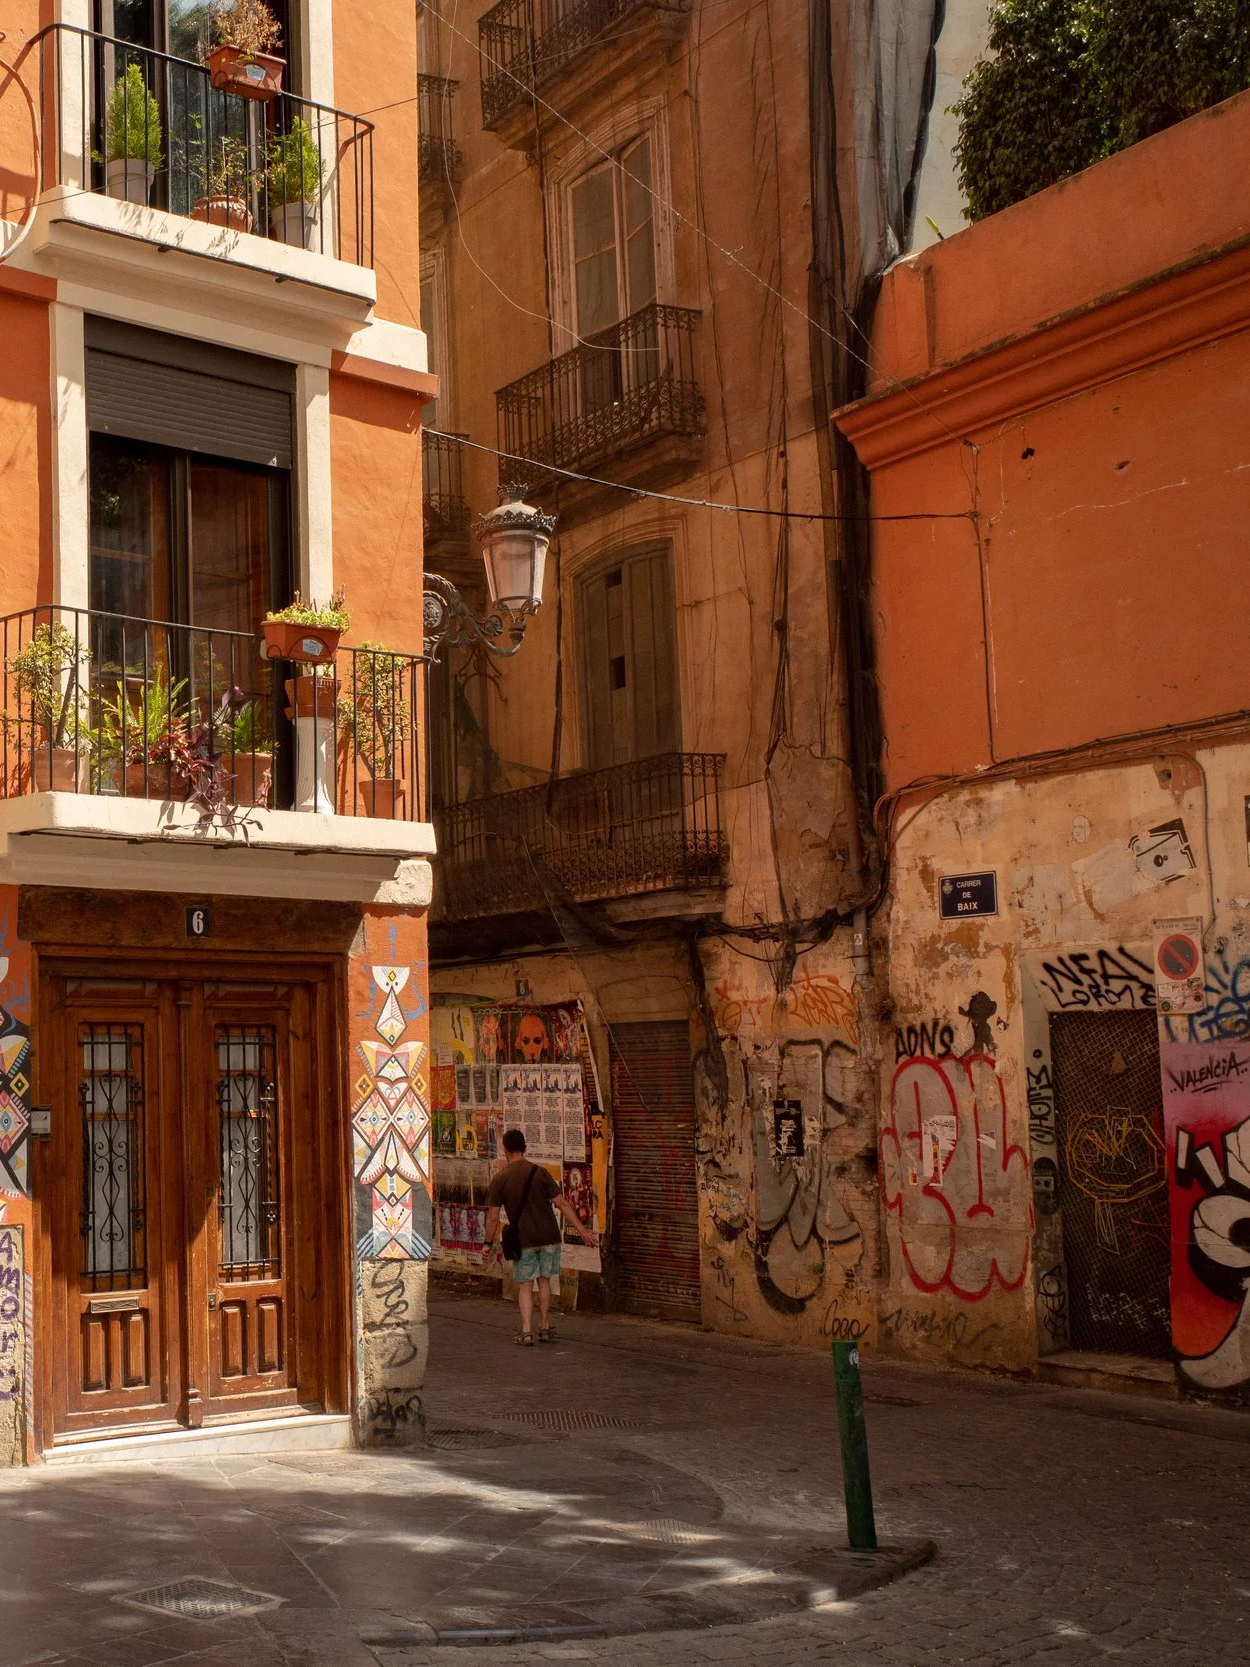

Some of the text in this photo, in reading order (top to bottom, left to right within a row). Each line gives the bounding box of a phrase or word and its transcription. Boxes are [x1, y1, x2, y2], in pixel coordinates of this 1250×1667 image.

[956, 879, 981, 889] CARRER
[962, 891, 972, 899] DE
[957, 901, 978, 911] BAIX
[192, 910, 204, 934] 6
